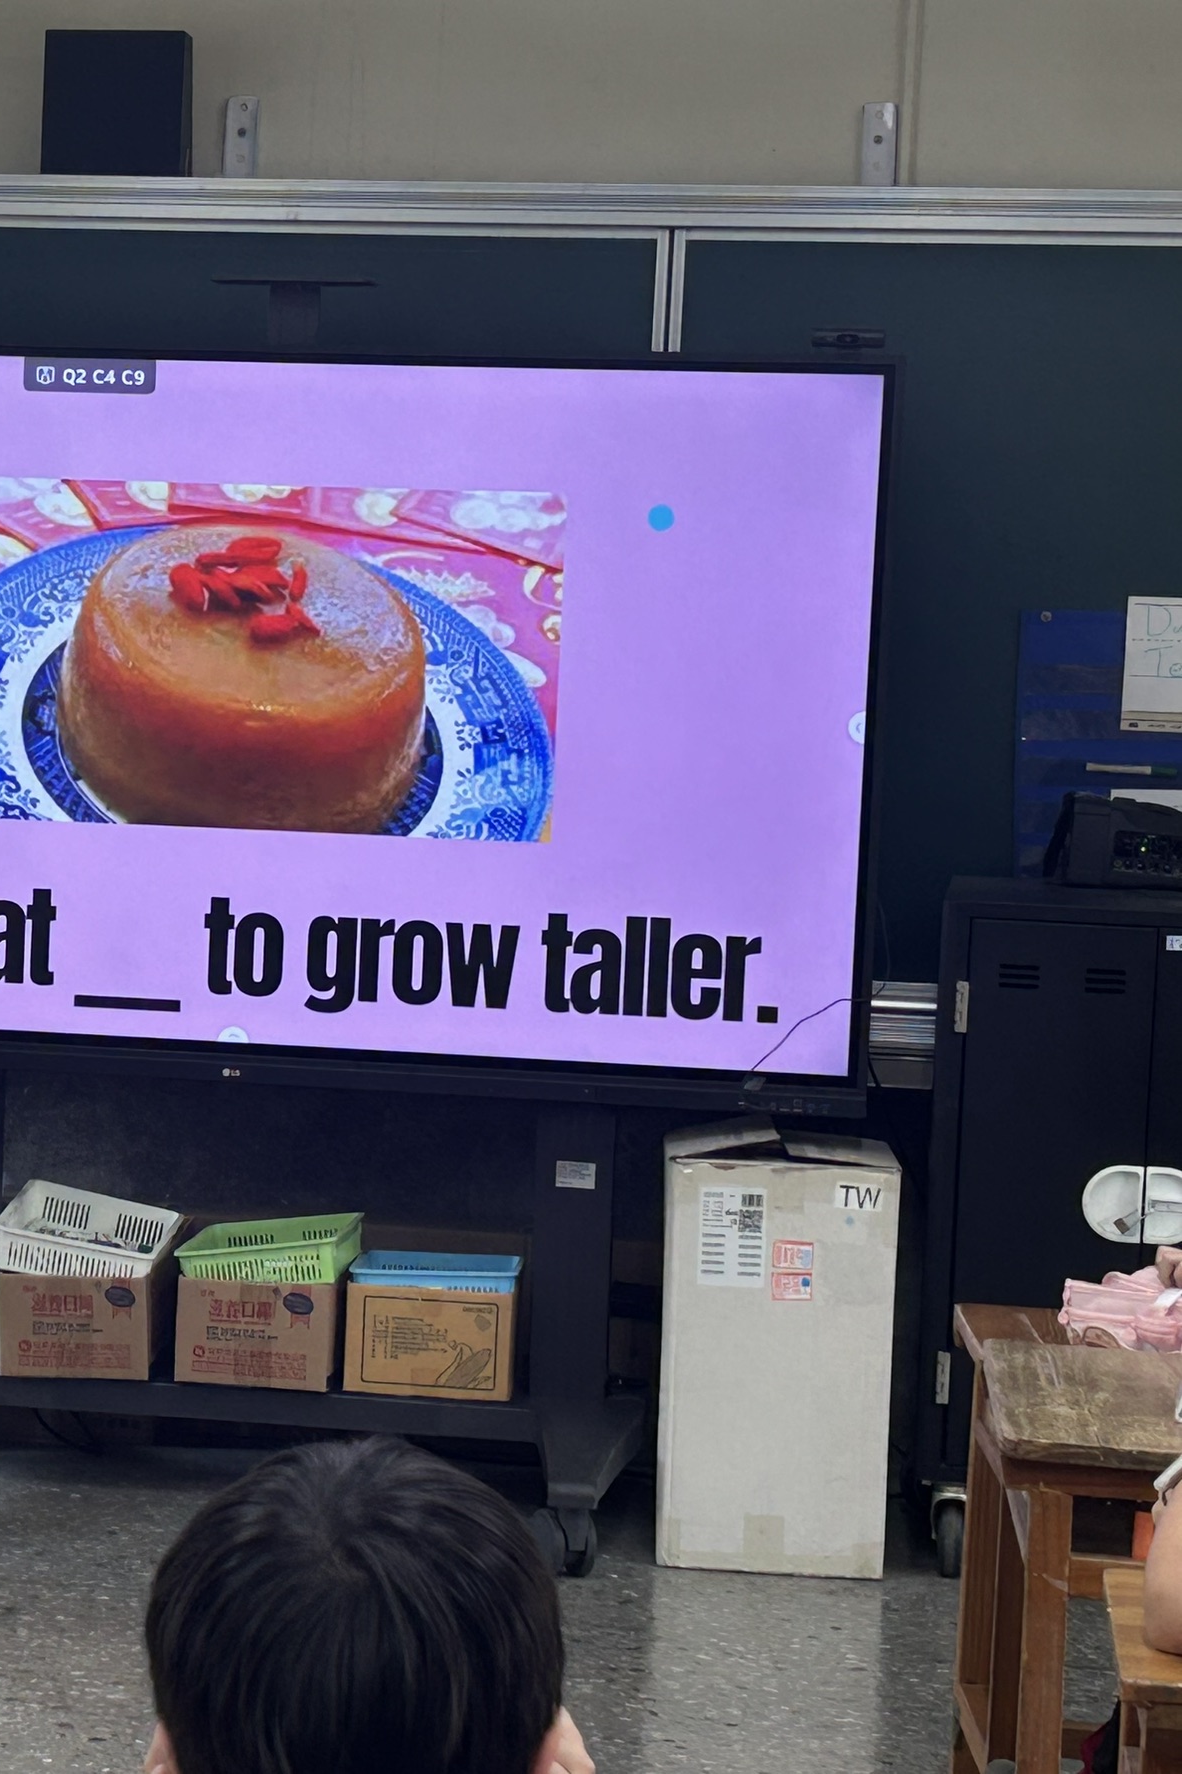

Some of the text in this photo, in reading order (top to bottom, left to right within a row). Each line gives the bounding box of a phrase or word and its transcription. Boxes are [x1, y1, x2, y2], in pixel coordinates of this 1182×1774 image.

[63, 368, 145, 386] Q2 C4 C9
[204, 896, 284, 997] to
[304, 915, 521, 1014] grow
[541, 912, 779, 1024] taller.
[839, 1184, 882, 1209] TW
